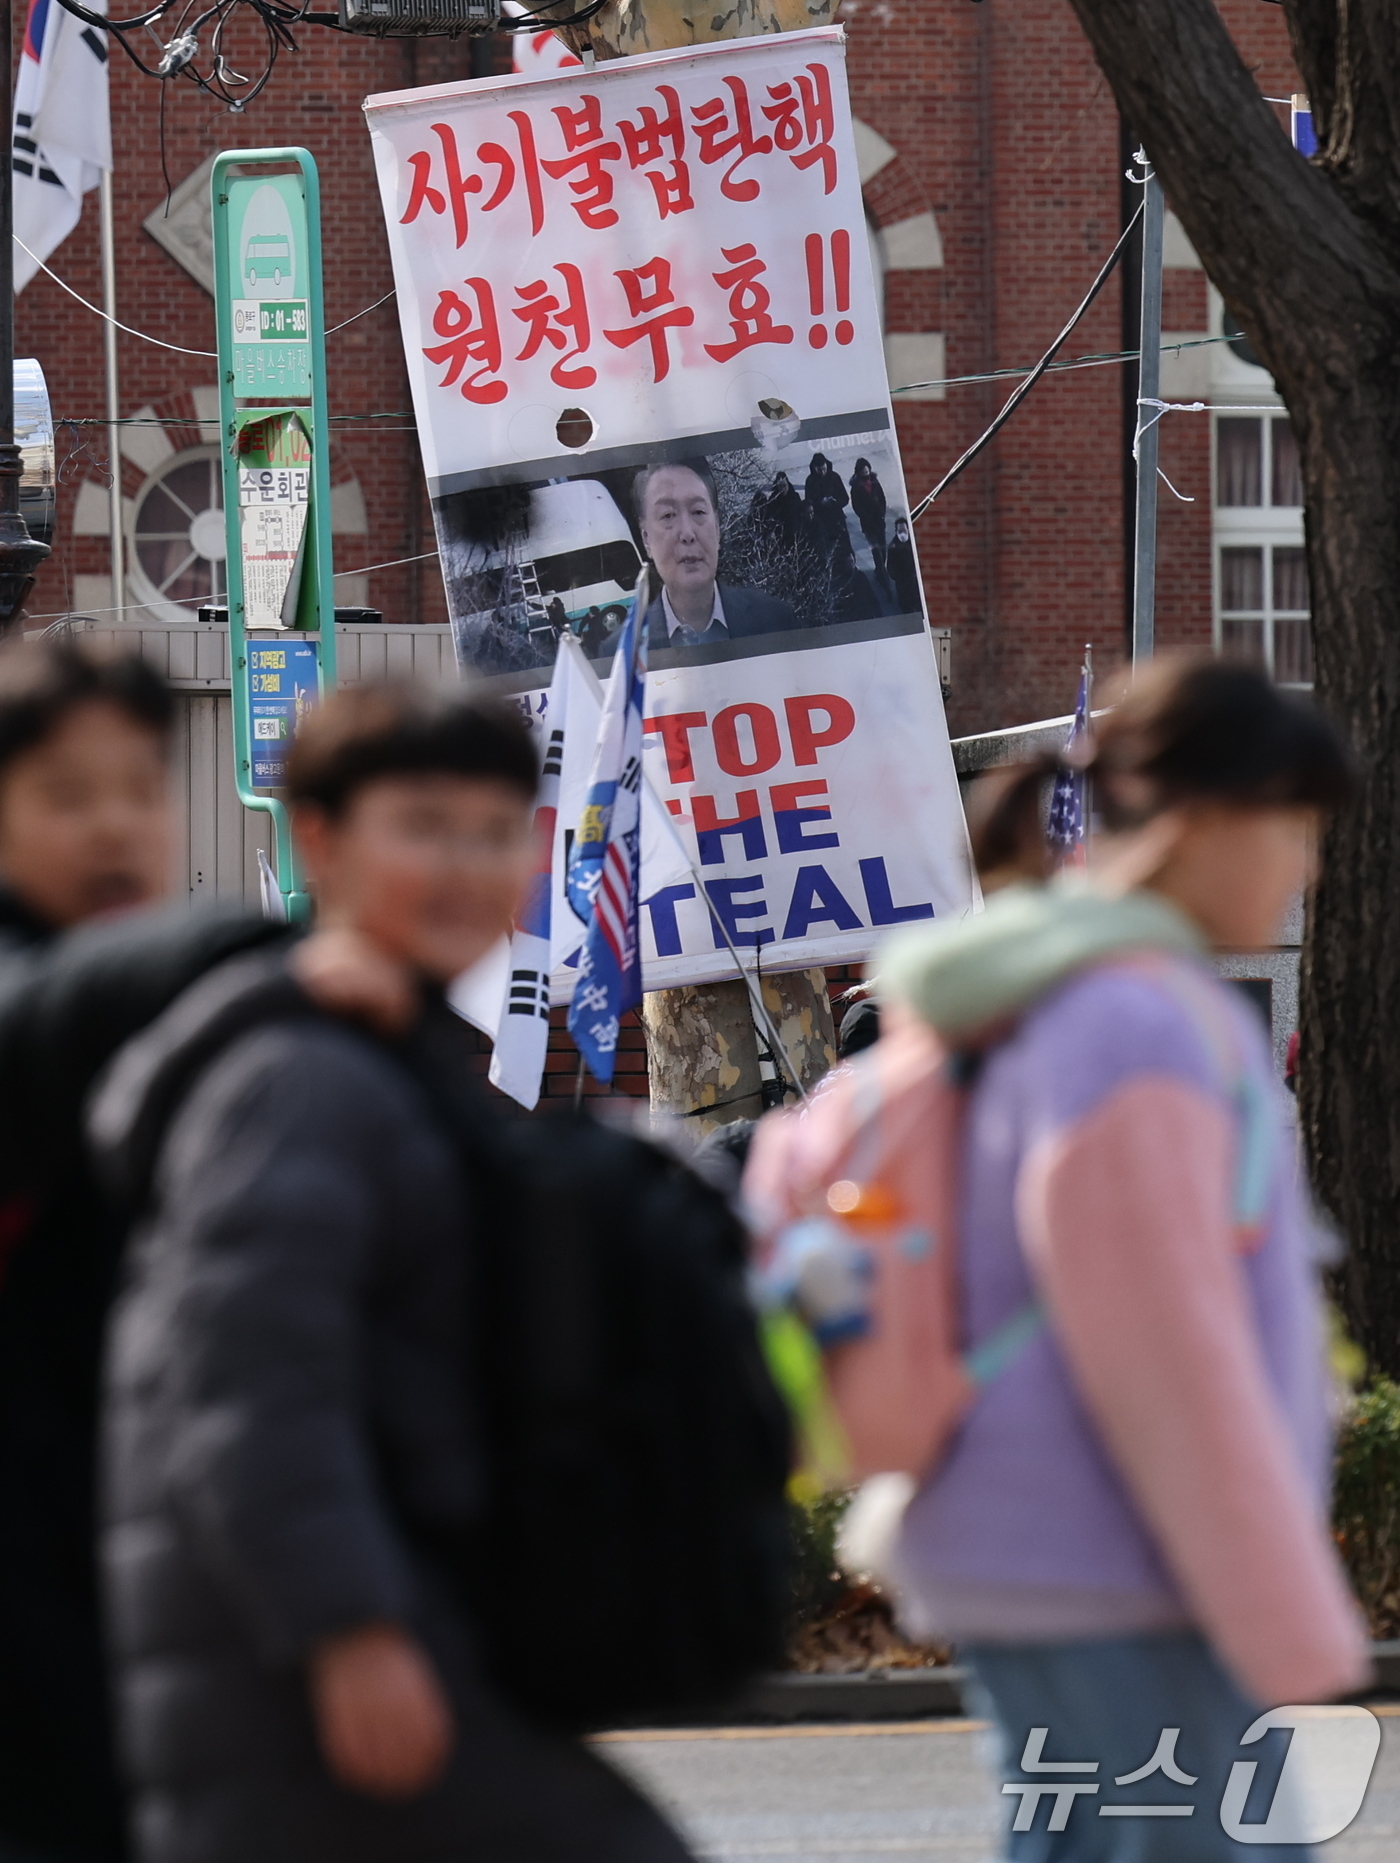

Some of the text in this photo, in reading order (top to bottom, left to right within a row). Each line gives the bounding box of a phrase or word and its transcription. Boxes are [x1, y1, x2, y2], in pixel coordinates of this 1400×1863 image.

[399, 62, 836, 250] 사기불법탄핵
[240, 471, 309, 503] 수운회관
[642, 693, 855, 784] TOP
[666, 779, 840, 865] HE
[563, 856, 935, 968] TEAL
